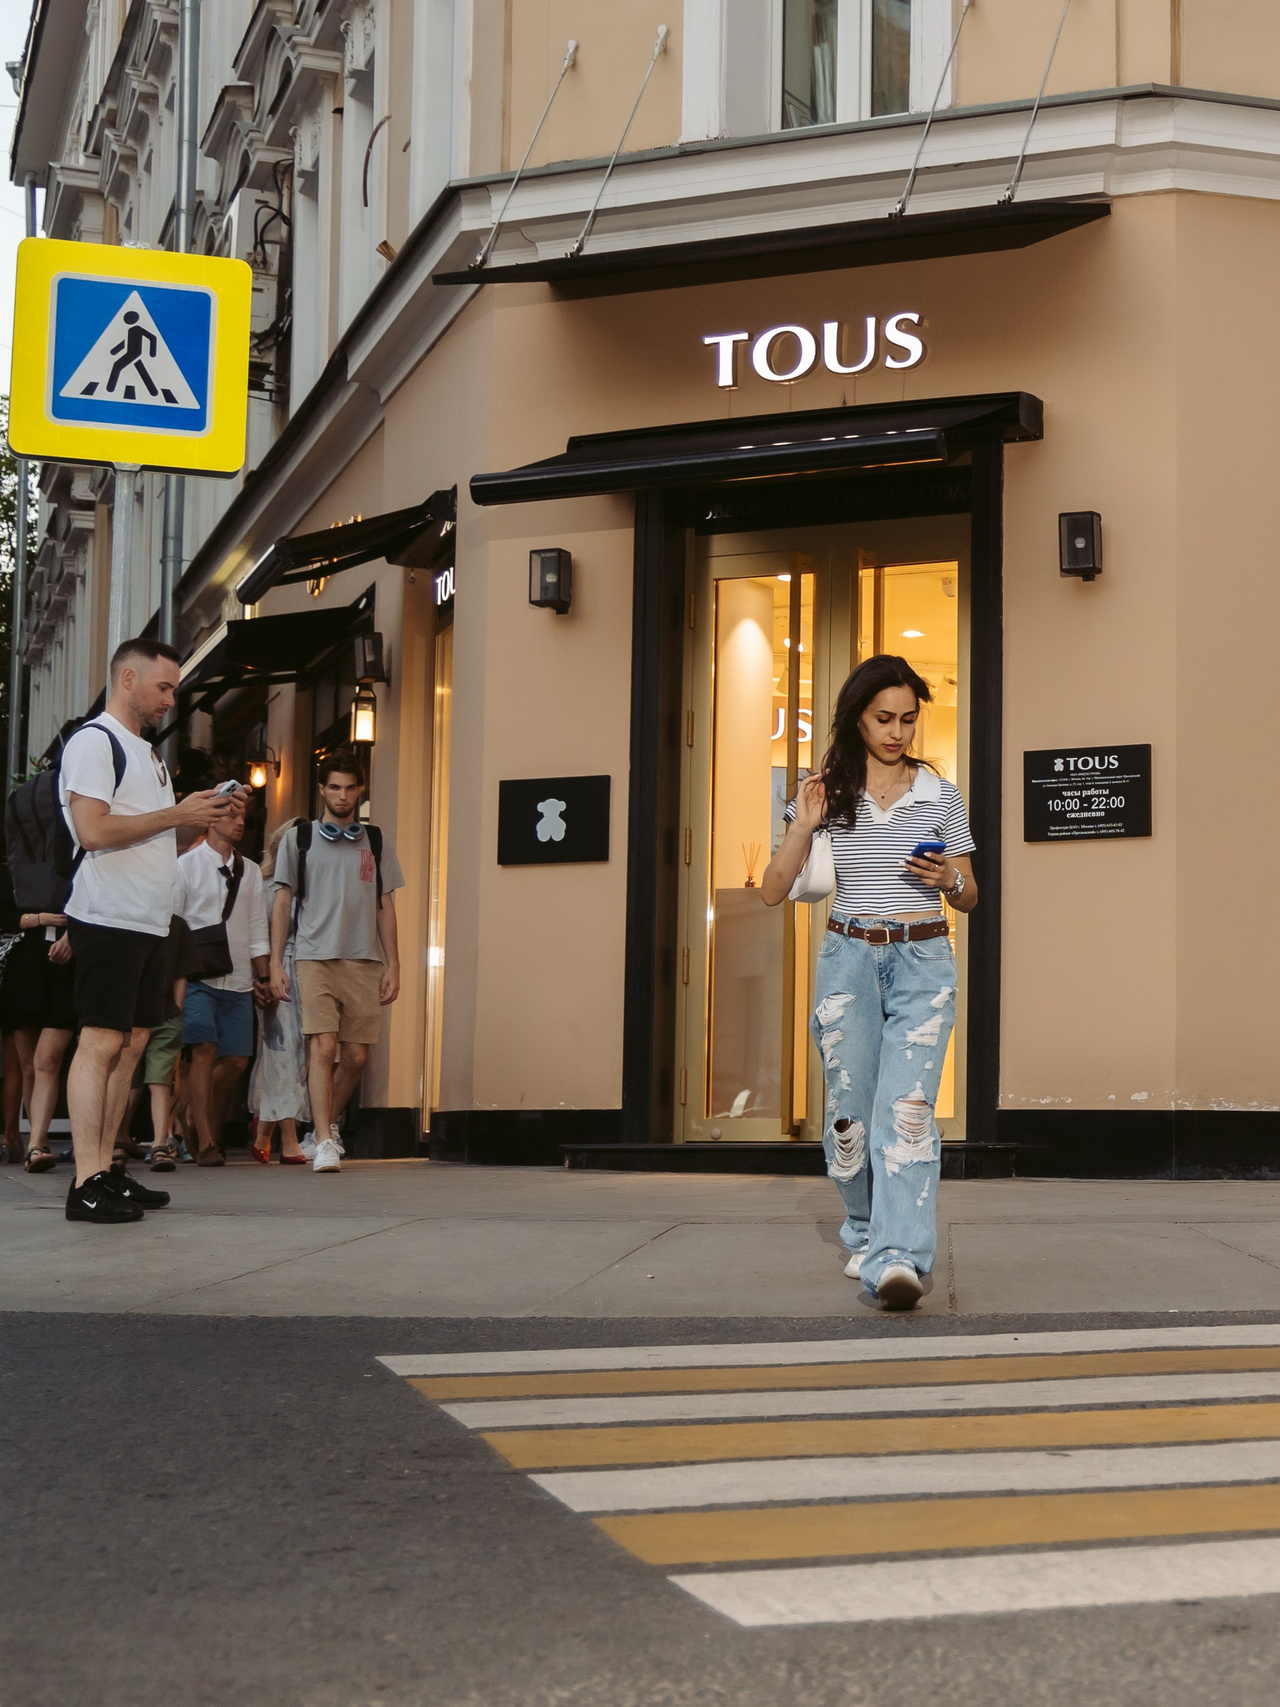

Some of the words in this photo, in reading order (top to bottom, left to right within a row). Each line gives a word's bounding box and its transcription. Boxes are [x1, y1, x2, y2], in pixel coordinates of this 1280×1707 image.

[702, 312, 924, 388] TOUS
[1066, 755, 1119, 770] TOUS
[1082, 788, 1109, 797] работы
[1047, 798, 1080, 811] 10:00
[1091, 796, 1125, 809] 22:00
